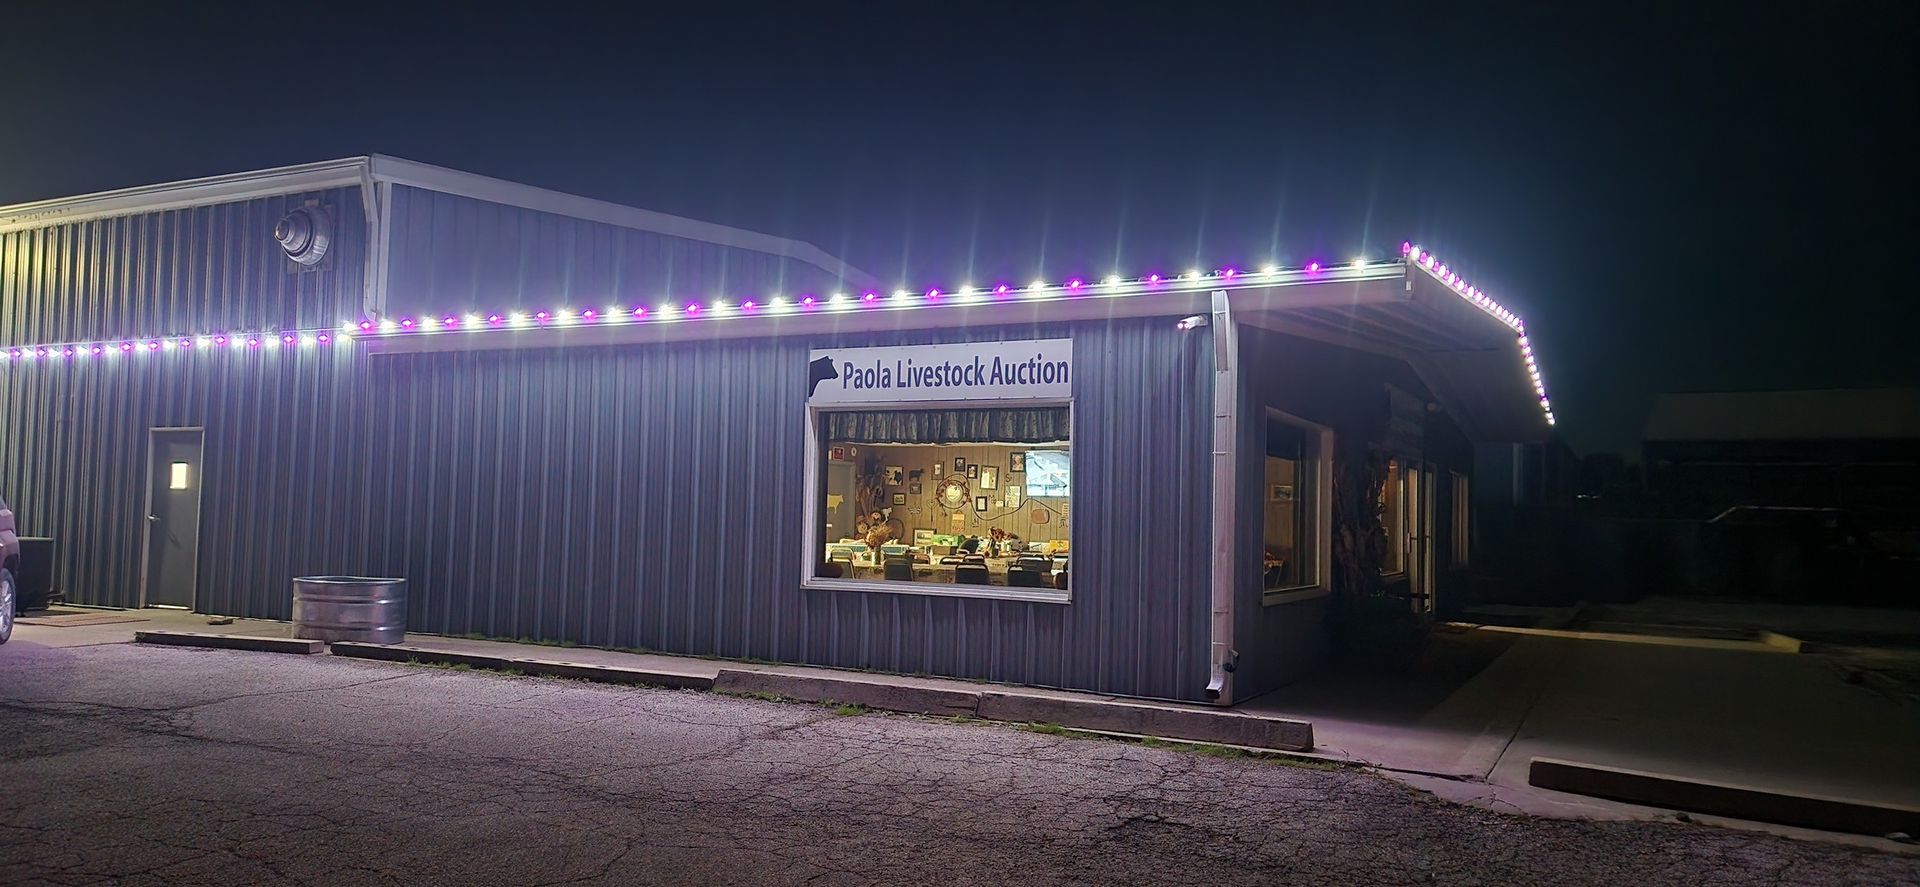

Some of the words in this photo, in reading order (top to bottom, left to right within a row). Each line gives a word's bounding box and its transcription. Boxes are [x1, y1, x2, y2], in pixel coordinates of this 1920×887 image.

[843, 359, 892, 390] Paola
[897, 356, 986, 388] Livestock
[990, 353, 1069, 385] Auction
